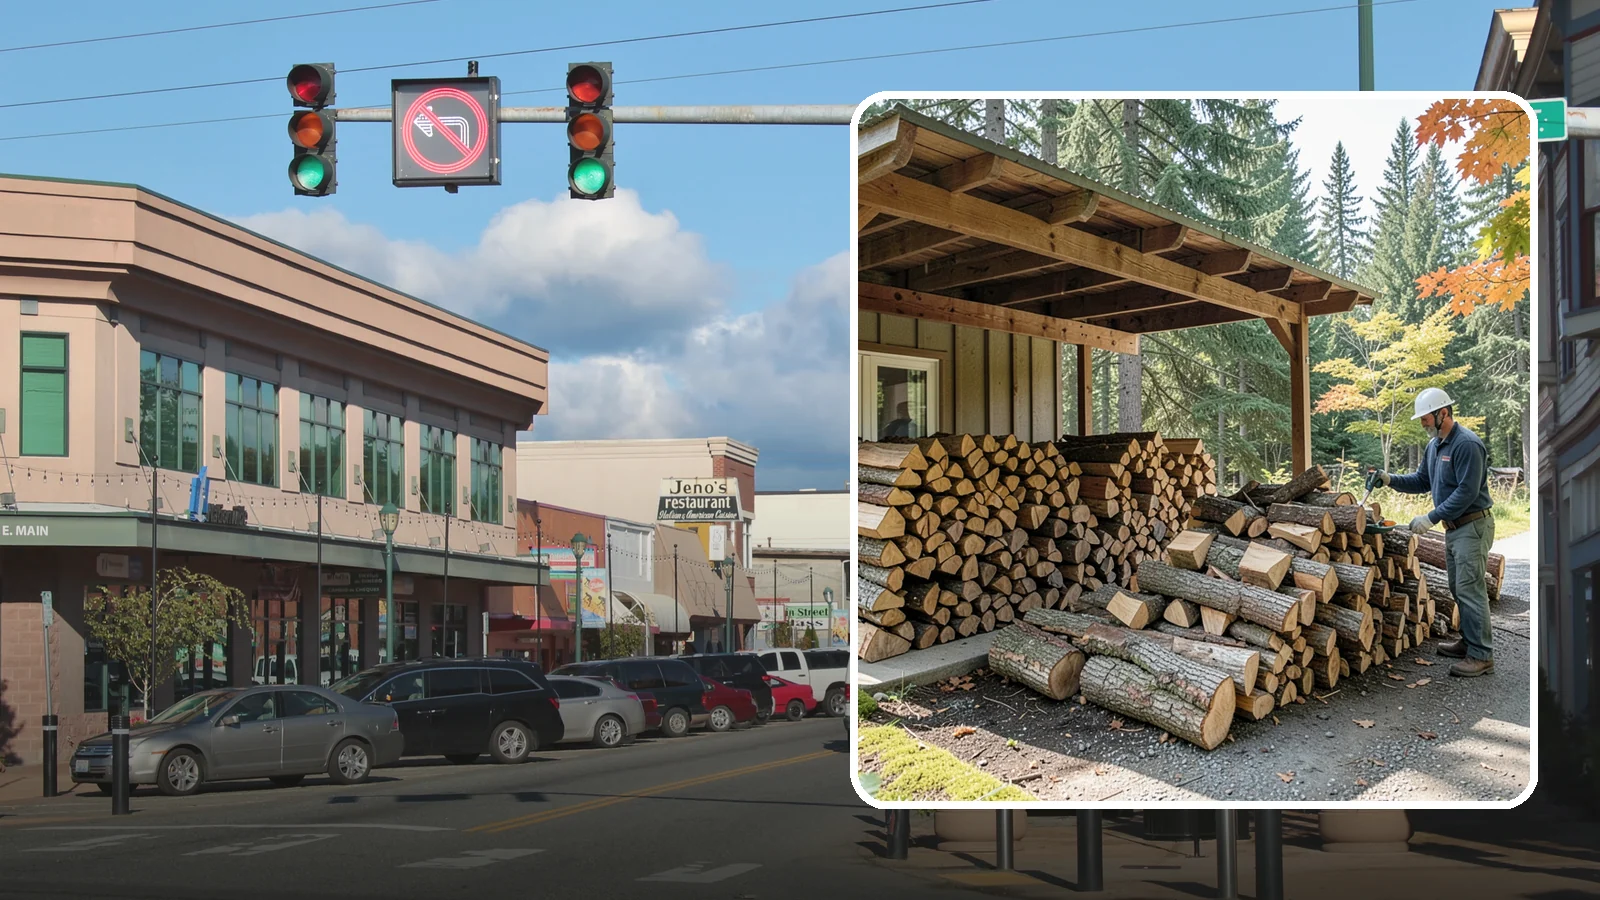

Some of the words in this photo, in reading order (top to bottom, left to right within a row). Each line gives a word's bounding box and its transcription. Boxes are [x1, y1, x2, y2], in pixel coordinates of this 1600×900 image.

[669, 480, 728, 495] Jeno's
[665, 496, 731, 509] restaurant
[658, 510, 681, 520] Italian
[685, 510, 715, 519] American
[714, 509, 738, 519] Cuisine
[2, 525, 13, 536] E.
[15, 525, 49, 536] MAIN
[785, 608, 795, 616] in
[797, 607, 828, 616] Street
